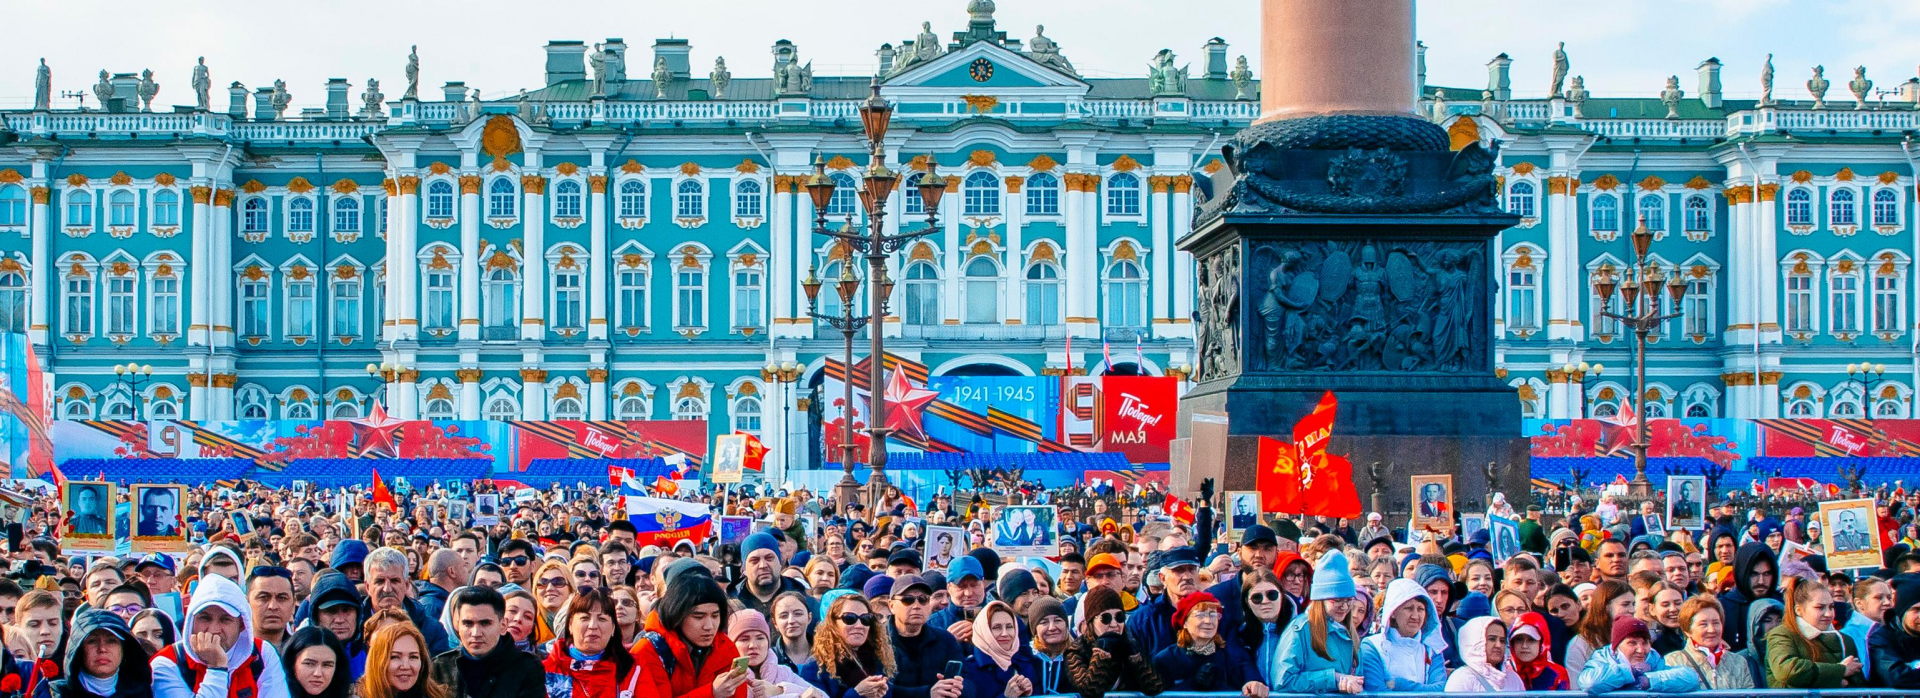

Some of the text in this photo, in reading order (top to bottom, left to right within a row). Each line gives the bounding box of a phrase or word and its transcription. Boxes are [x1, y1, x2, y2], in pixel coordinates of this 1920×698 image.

[1066, 383, 1105, 448] 9
[1118, 392, 1162, 432] Победа!
[160, 426, 180, 459] 9
[199, 444, 234, 458] МАЯ
[584, 427, 619, 459] Победа!
[1111, 431, 1146, 444] МАЯ
[1830, 425, 1865, 457] Победа!
[654, 529, 690, 541] РОССИЯ
